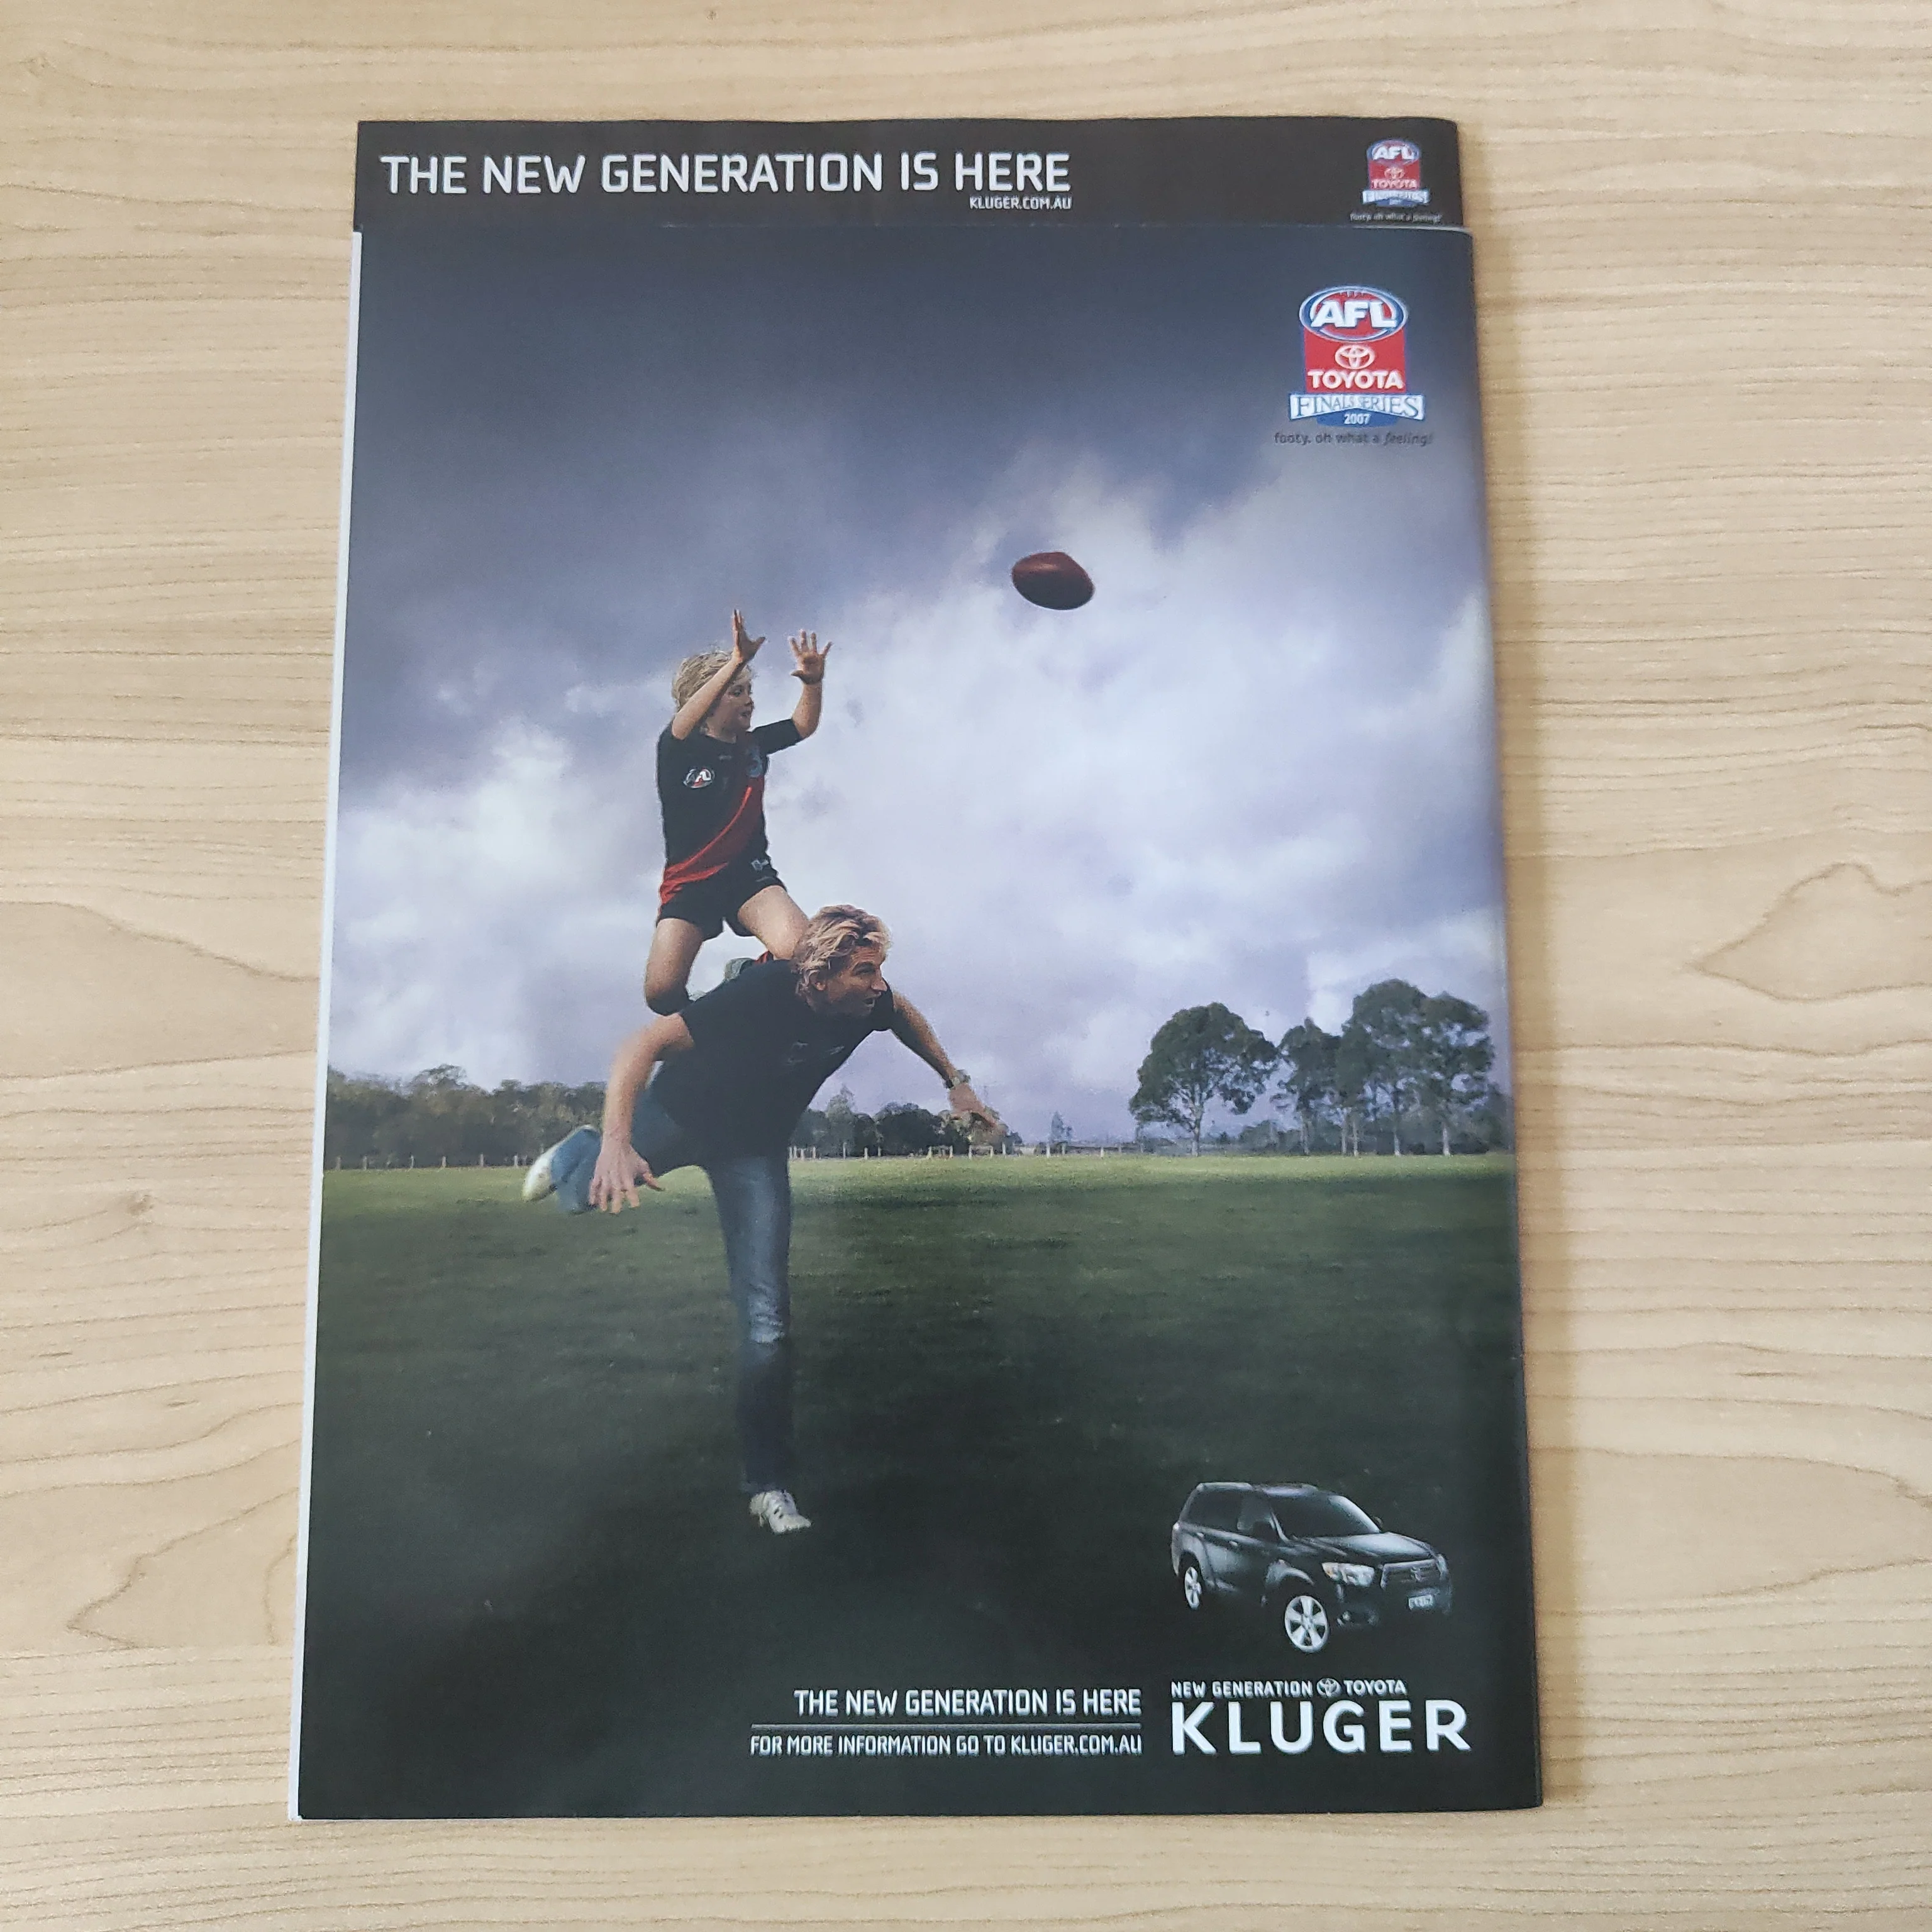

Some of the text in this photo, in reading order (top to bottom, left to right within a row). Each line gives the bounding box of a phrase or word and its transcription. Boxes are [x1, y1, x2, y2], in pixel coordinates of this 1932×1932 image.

[1372, 145, 1414, 160] AFL
[379, 151, 1071, 194] THE NEW GENERATION IS HERE
[1372, 179, 1418, 189] TOYOTA
[969, 195, 1072, 210] KLUGER.COM.AU
[1310, 299, 1397, 328] AFL
[1307, 369, 1404, 389] TOYOTA
[1343, 413, 1371, 425] 2007
[1315, 433, 1332, 444] oh
[1171, 1679, 1407, 1698] NEW GENERATION TOYOTA
[793, 1689, 1142, 1717] THE NEW GENERATION IS HERE
[1172, 1699, 1471, 1755] KLUGER
[750, 1734, 1143, 1757] FOR MORE INFORMATION GO TO KLUGER.COM.AU
